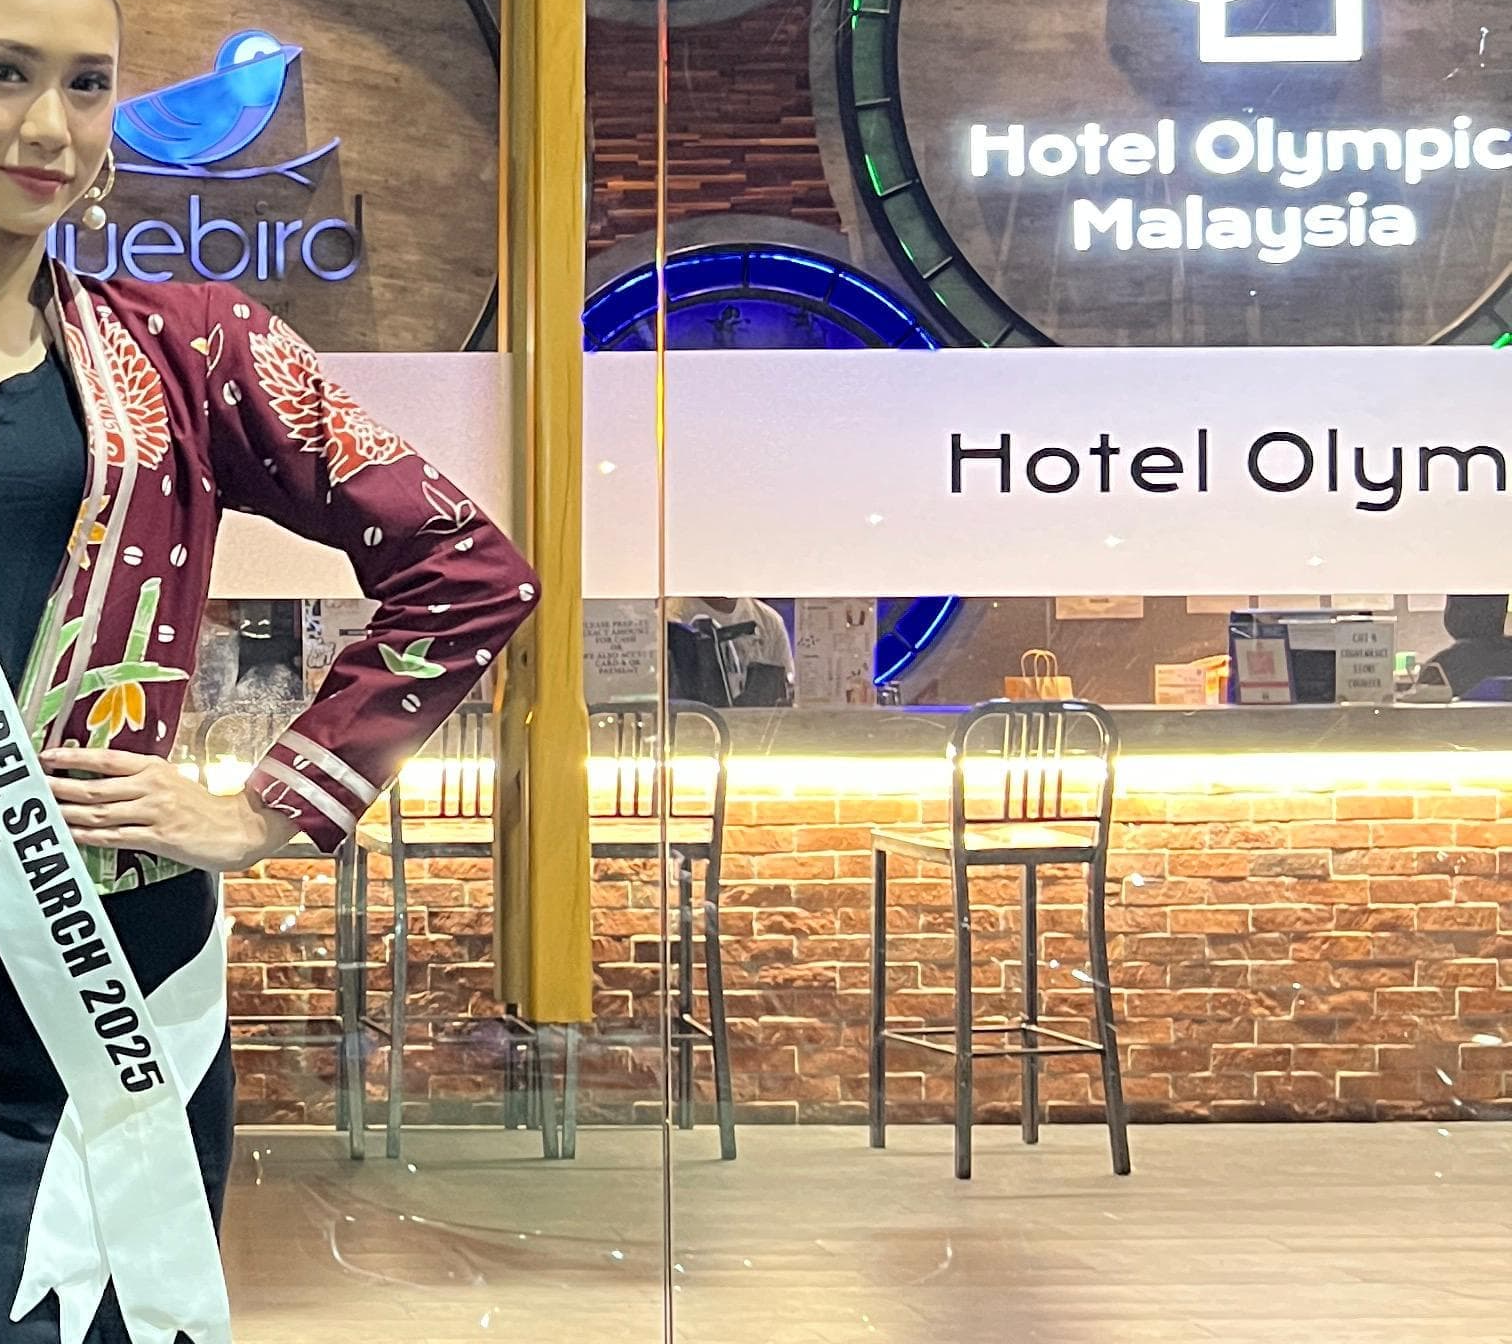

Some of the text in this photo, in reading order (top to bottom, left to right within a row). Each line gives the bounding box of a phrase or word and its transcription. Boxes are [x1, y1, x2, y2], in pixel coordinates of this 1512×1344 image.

[969, 115, 1512, 188] Hotel Olympic
[1072, 191, 1417, 264] Malaysia
[950, 428, 1208, 493] Hotel
[1, 797, 113, 979] SEARCH
[78, 979, 166, 1094] 2025
